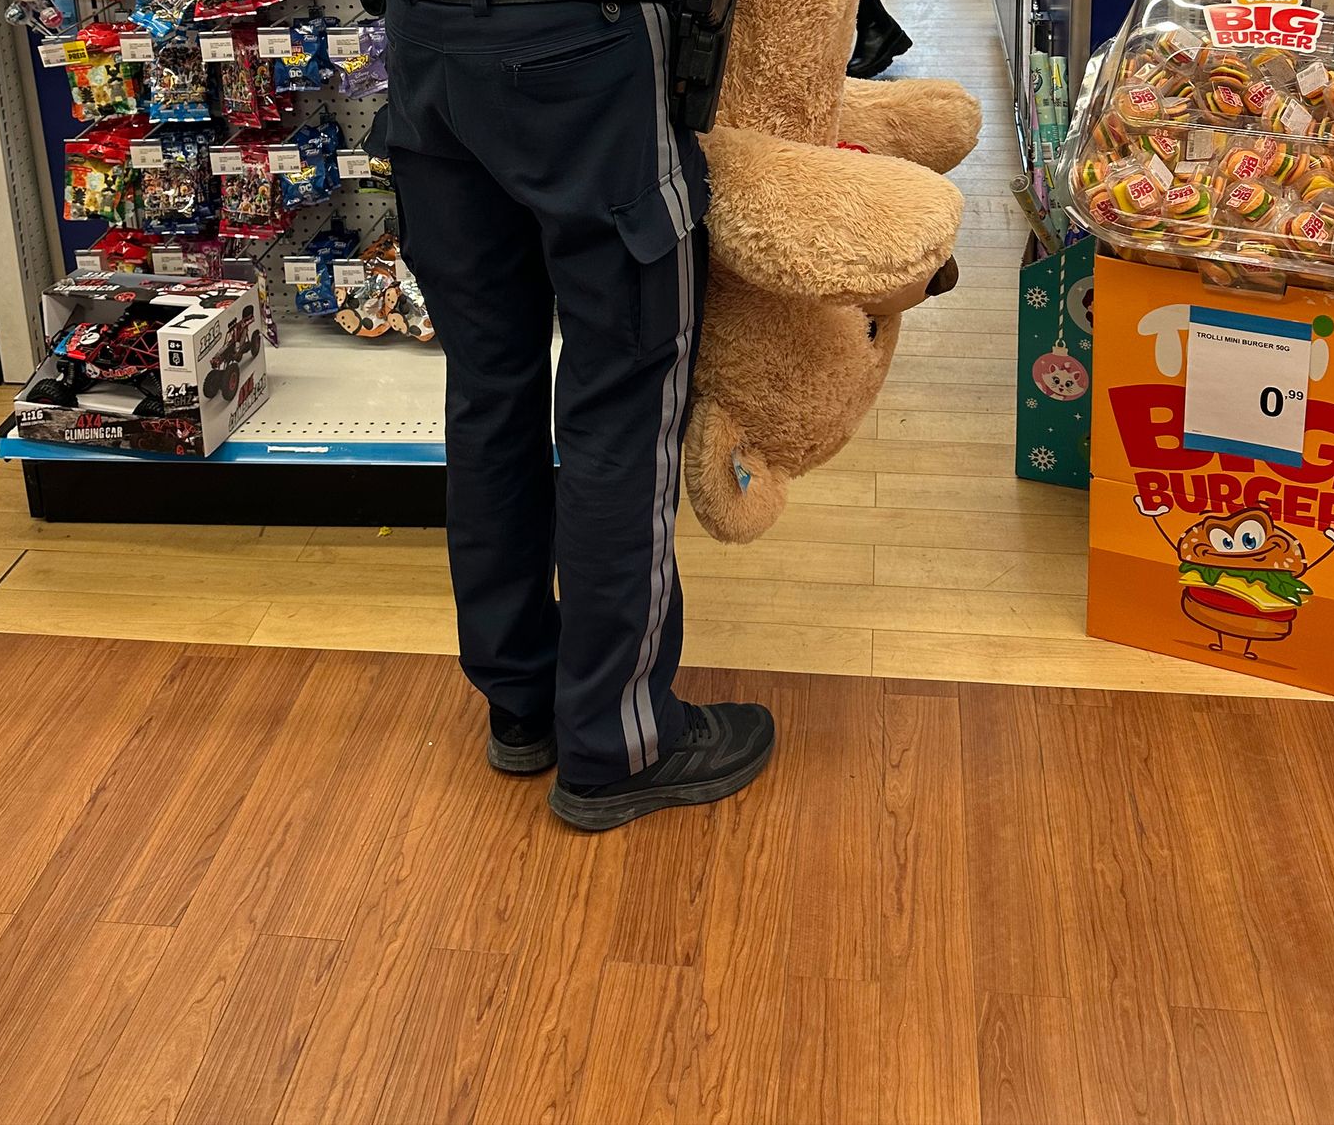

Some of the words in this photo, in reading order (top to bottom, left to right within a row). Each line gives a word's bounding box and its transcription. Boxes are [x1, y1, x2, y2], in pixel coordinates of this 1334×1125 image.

[1209, 6, 1320, 36] BIG
[1216, 31, 1313, 51] BURGER
[69, 52, 86, 60] PREIS
[289, 69, 303, 78] DC
[1130, 93, 1157, 104] BIG
[1249, 85, 1274, 104] BIG
[1240, 155, 1259, 178] BIG
[299, 183, 312, 193] DC
[1130, 183, 1155, 200] BIG
[1231, 188, 1253, 201] BIG
[1306, 216, 1324, 240] BIG
[169, 341, 181, 349] 8+
[1196, 331, 1223, 341] TROLLI
[1224, 336, 1240, 344] MINI
[1242, 339, 1274, 350] BURGER
[1275, 344, 1290, 352] 50G
[168, 384, 186, 397] 2.4
[173, 396, 193, 407] GHZ
[1259, 386, 1304, 418] 0,99
[21, 411, 43, 422] 1:16
[77, 413, 102, 428] 4X4
[64, 427, 105, 441] CLIMBING
[105, 426, 123, 438] CAR
